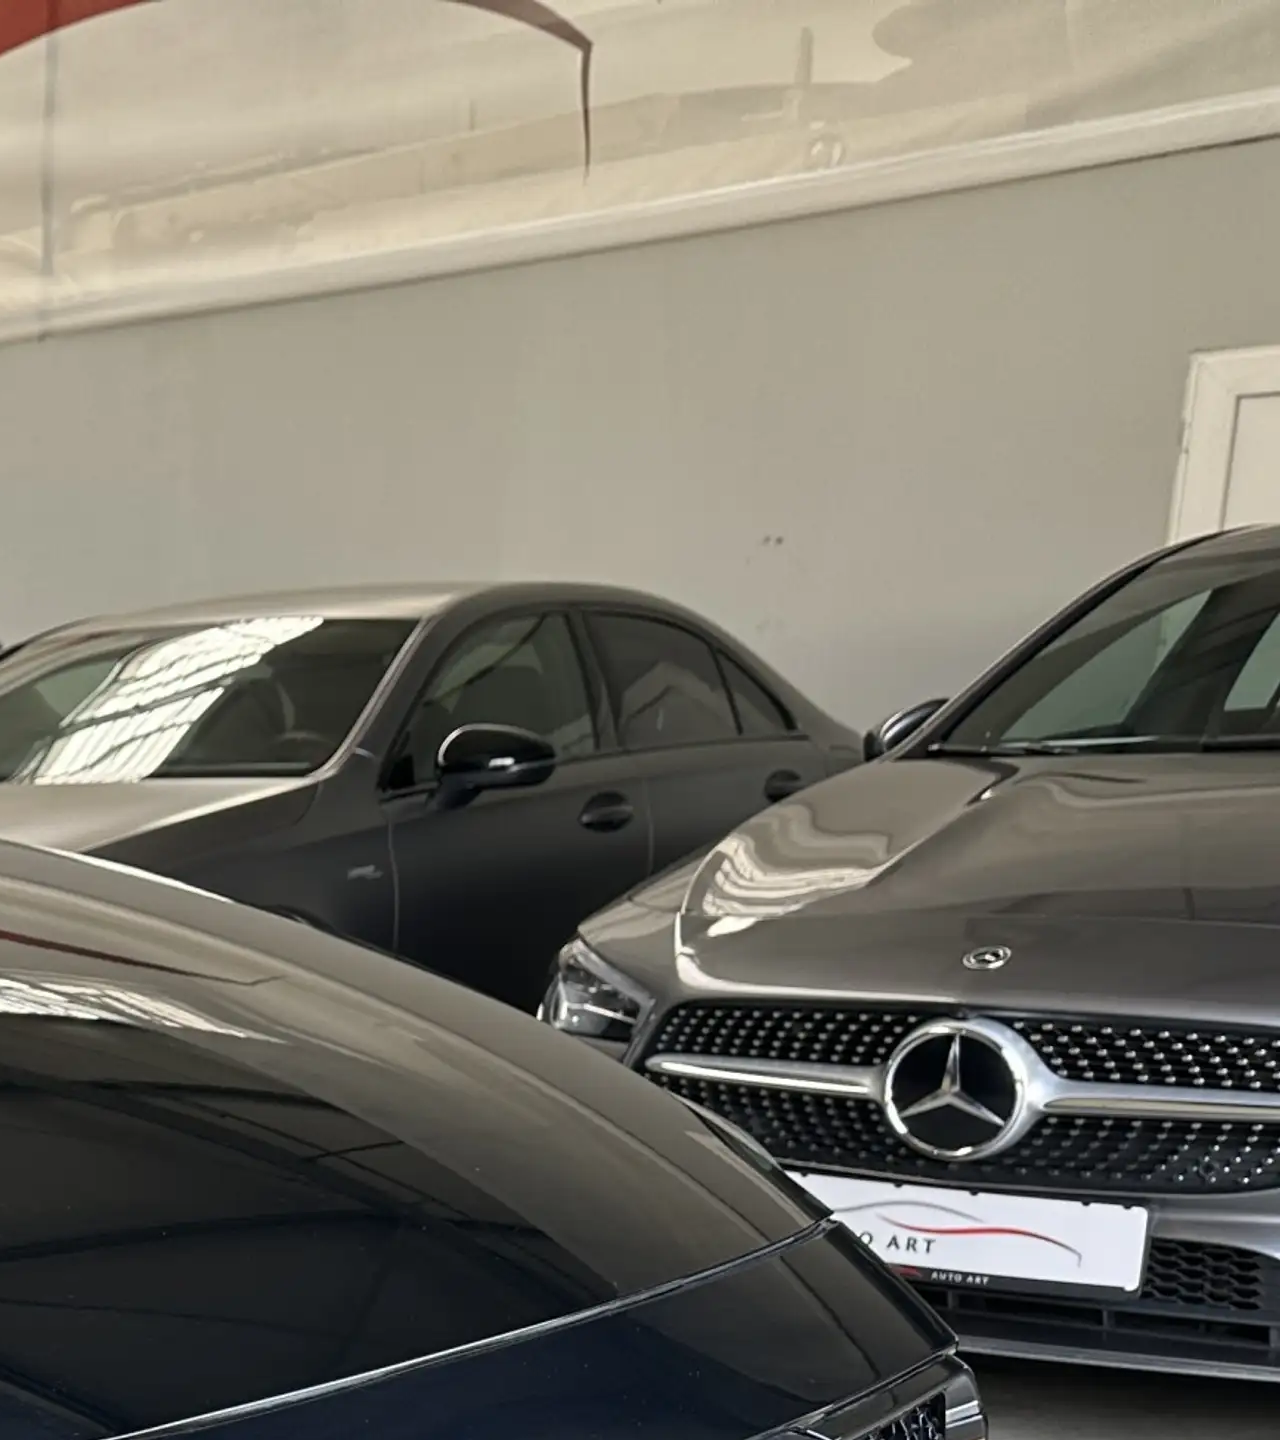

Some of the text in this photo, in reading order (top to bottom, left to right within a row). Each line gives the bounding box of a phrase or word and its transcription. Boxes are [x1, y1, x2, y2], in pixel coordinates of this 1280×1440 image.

[886, 1235, 937, 1254] ART
[931, 1271, 990, 1286] AUTO ART
